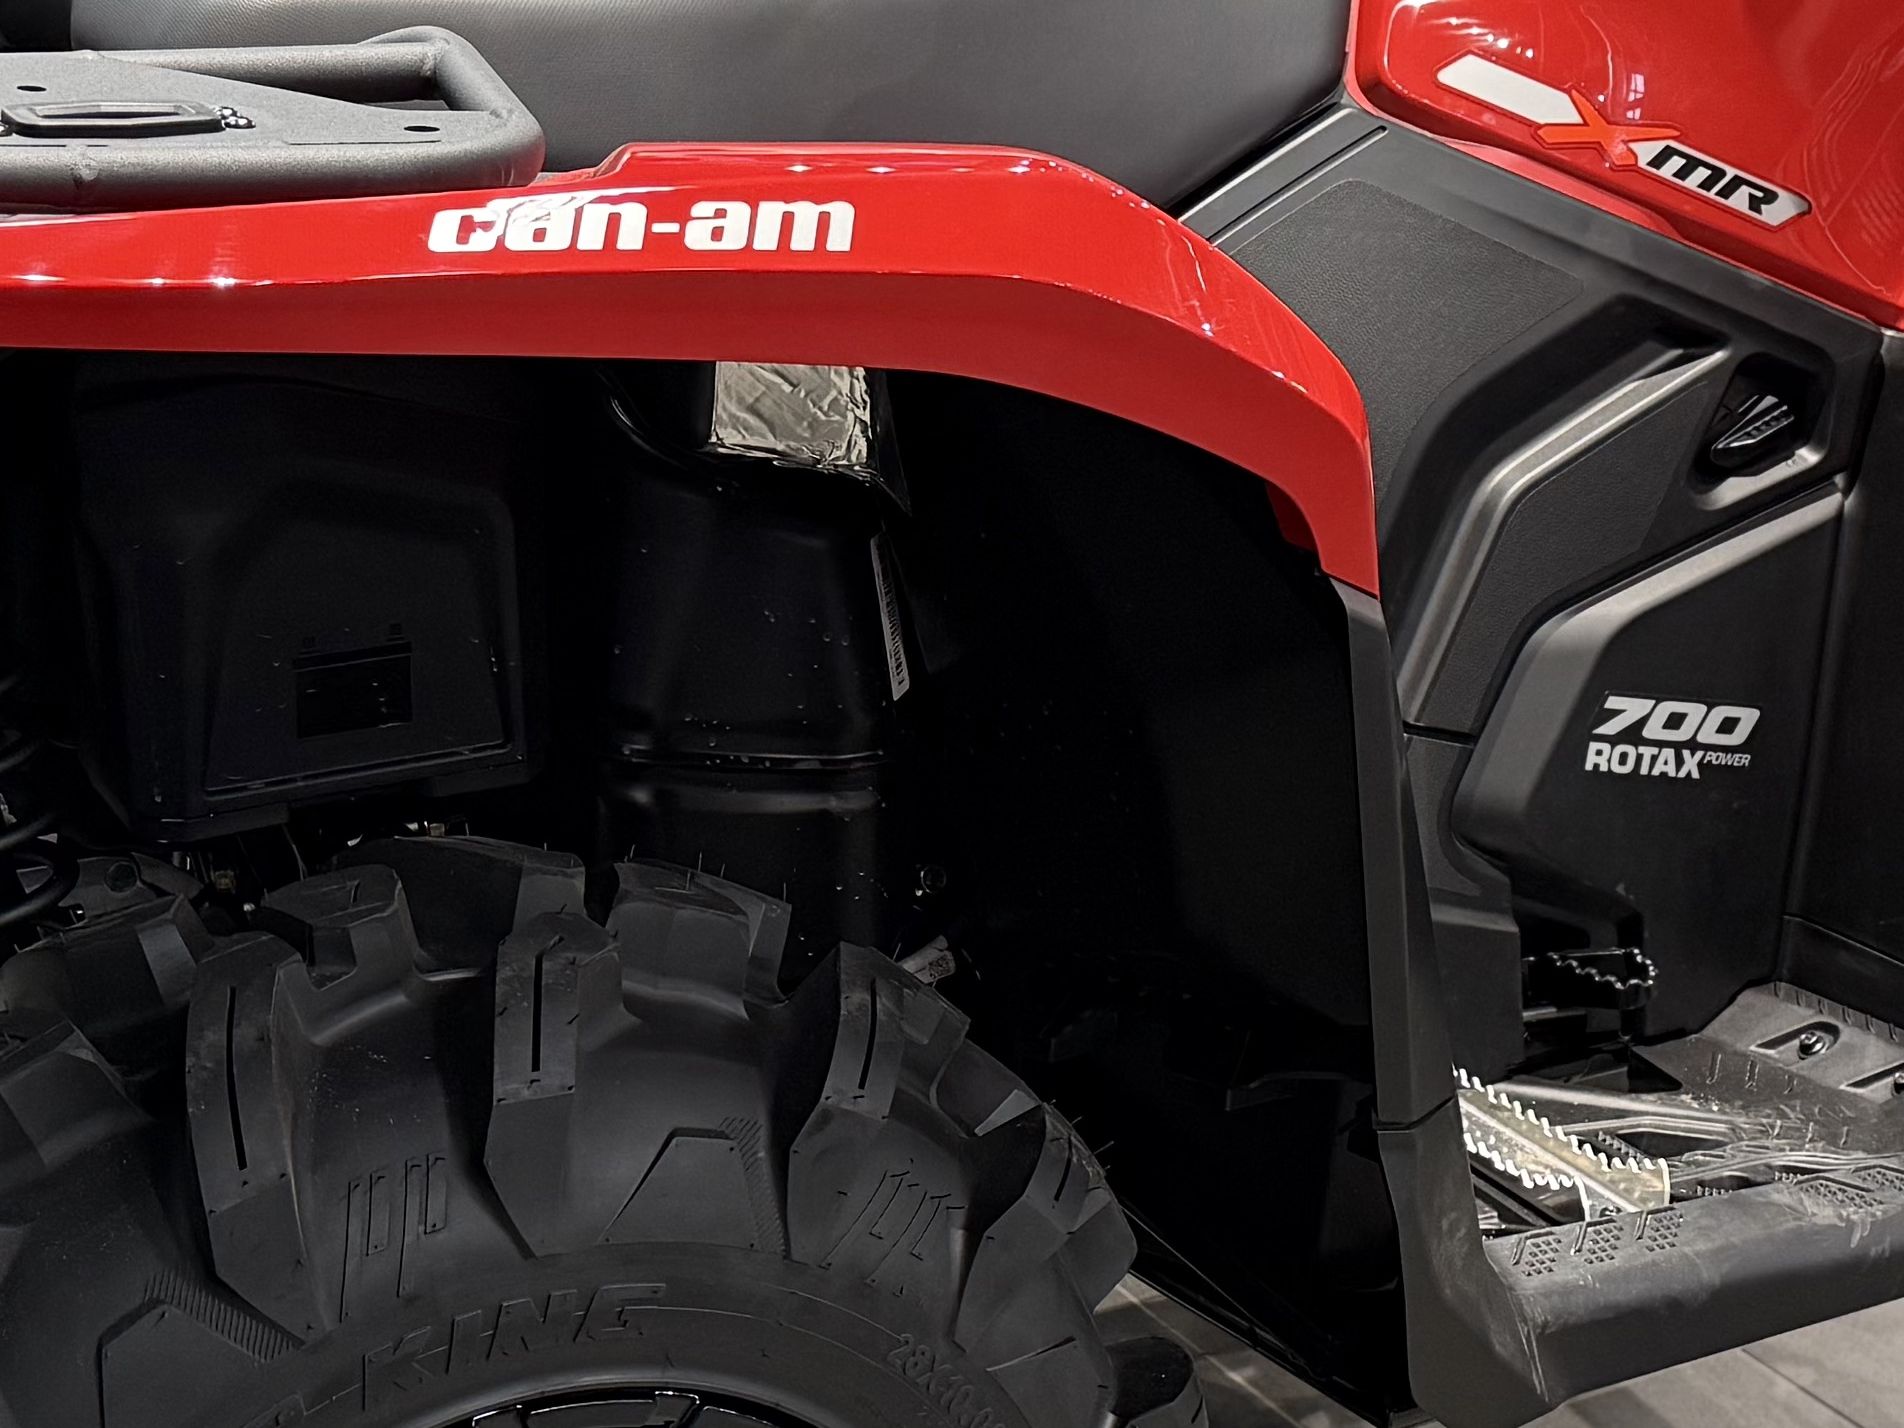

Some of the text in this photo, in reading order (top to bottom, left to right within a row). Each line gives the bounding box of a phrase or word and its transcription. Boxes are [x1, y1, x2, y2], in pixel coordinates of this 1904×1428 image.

[427, 199, 856, 254] can-am
[1592, 695, 1761, 746] 700
[1584, 741, 1751, 779] ROTAX POWER
